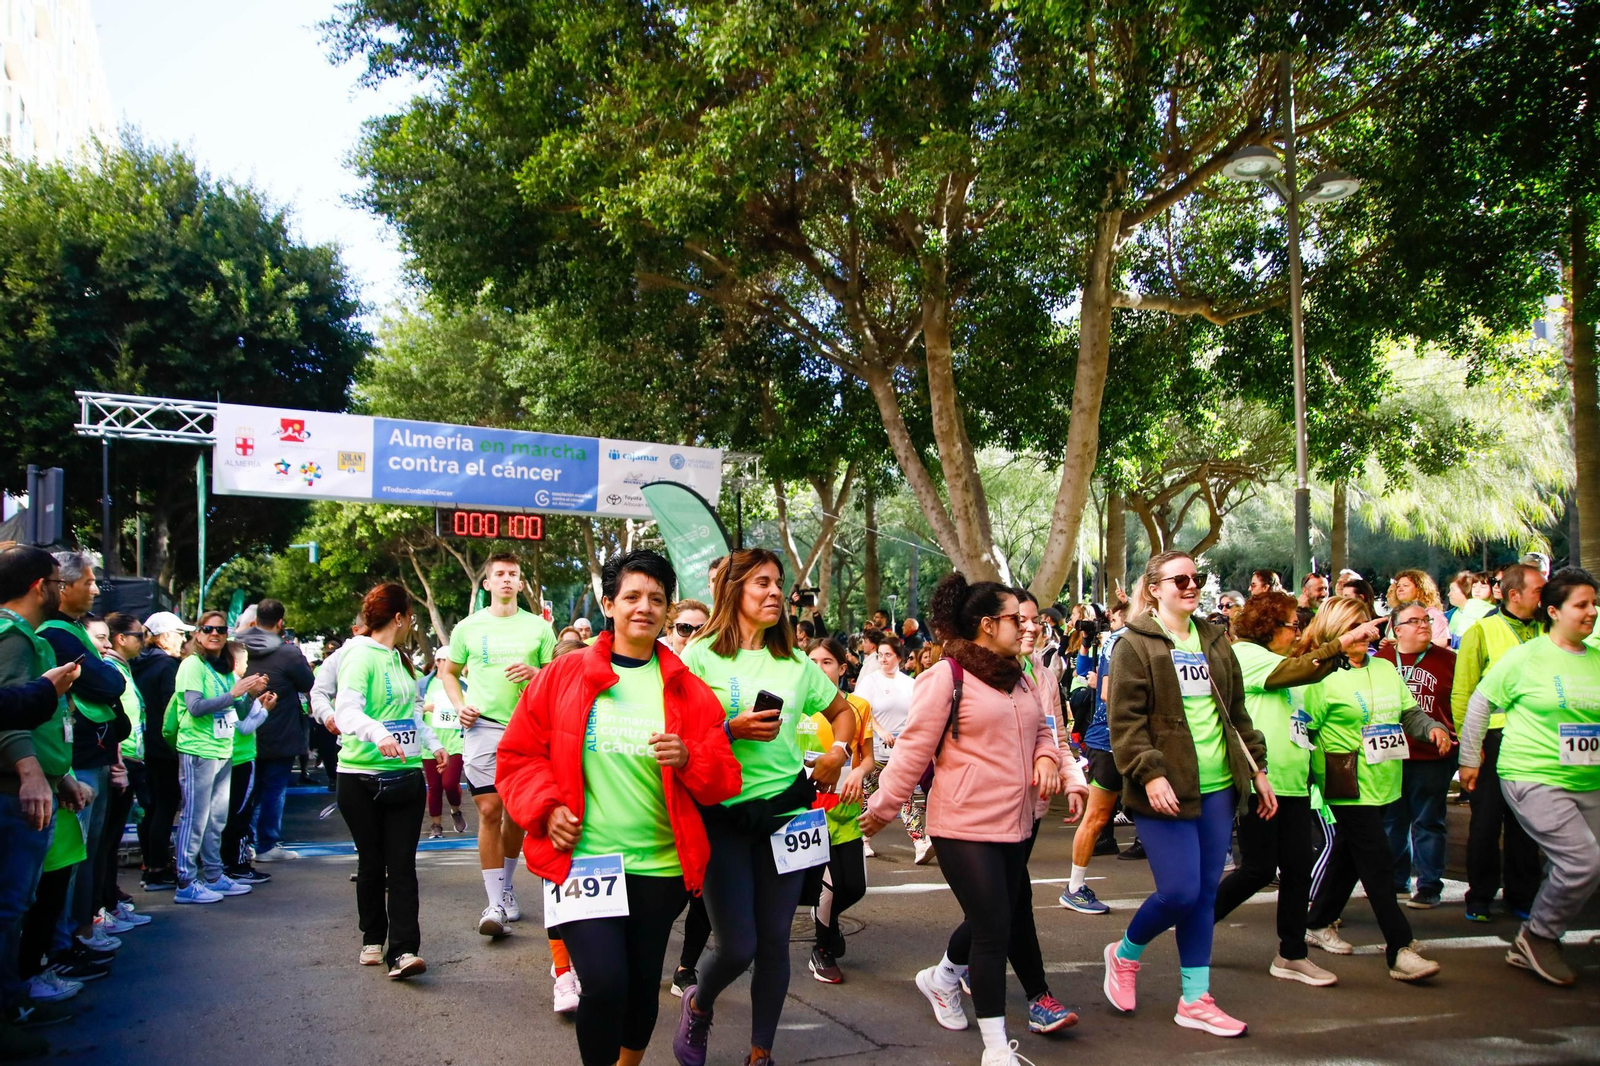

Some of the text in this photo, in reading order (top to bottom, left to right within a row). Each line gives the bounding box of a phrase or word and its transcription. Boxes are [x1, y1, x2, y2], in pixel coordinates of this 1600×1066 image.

[389, 428, 587, 462] Almería en marcha
[224, 458, 262, 469] ALMERÍA
[622, 451, 659, 463] cajamar
[388, 455, 563, 482] contra el cáncer
[1179, 665, 1209, 681] 100
[600, 725, 648, 739] contra
[1294, 721, 1309, 737] 15
[600, 737, 655, 758] cánce
[1368, 734, 1406, 751] 1524
[1565, 737, 1600, 752] 100
[784, 828, 822, 853] 994
[551, 875, 618, 904] 1497
